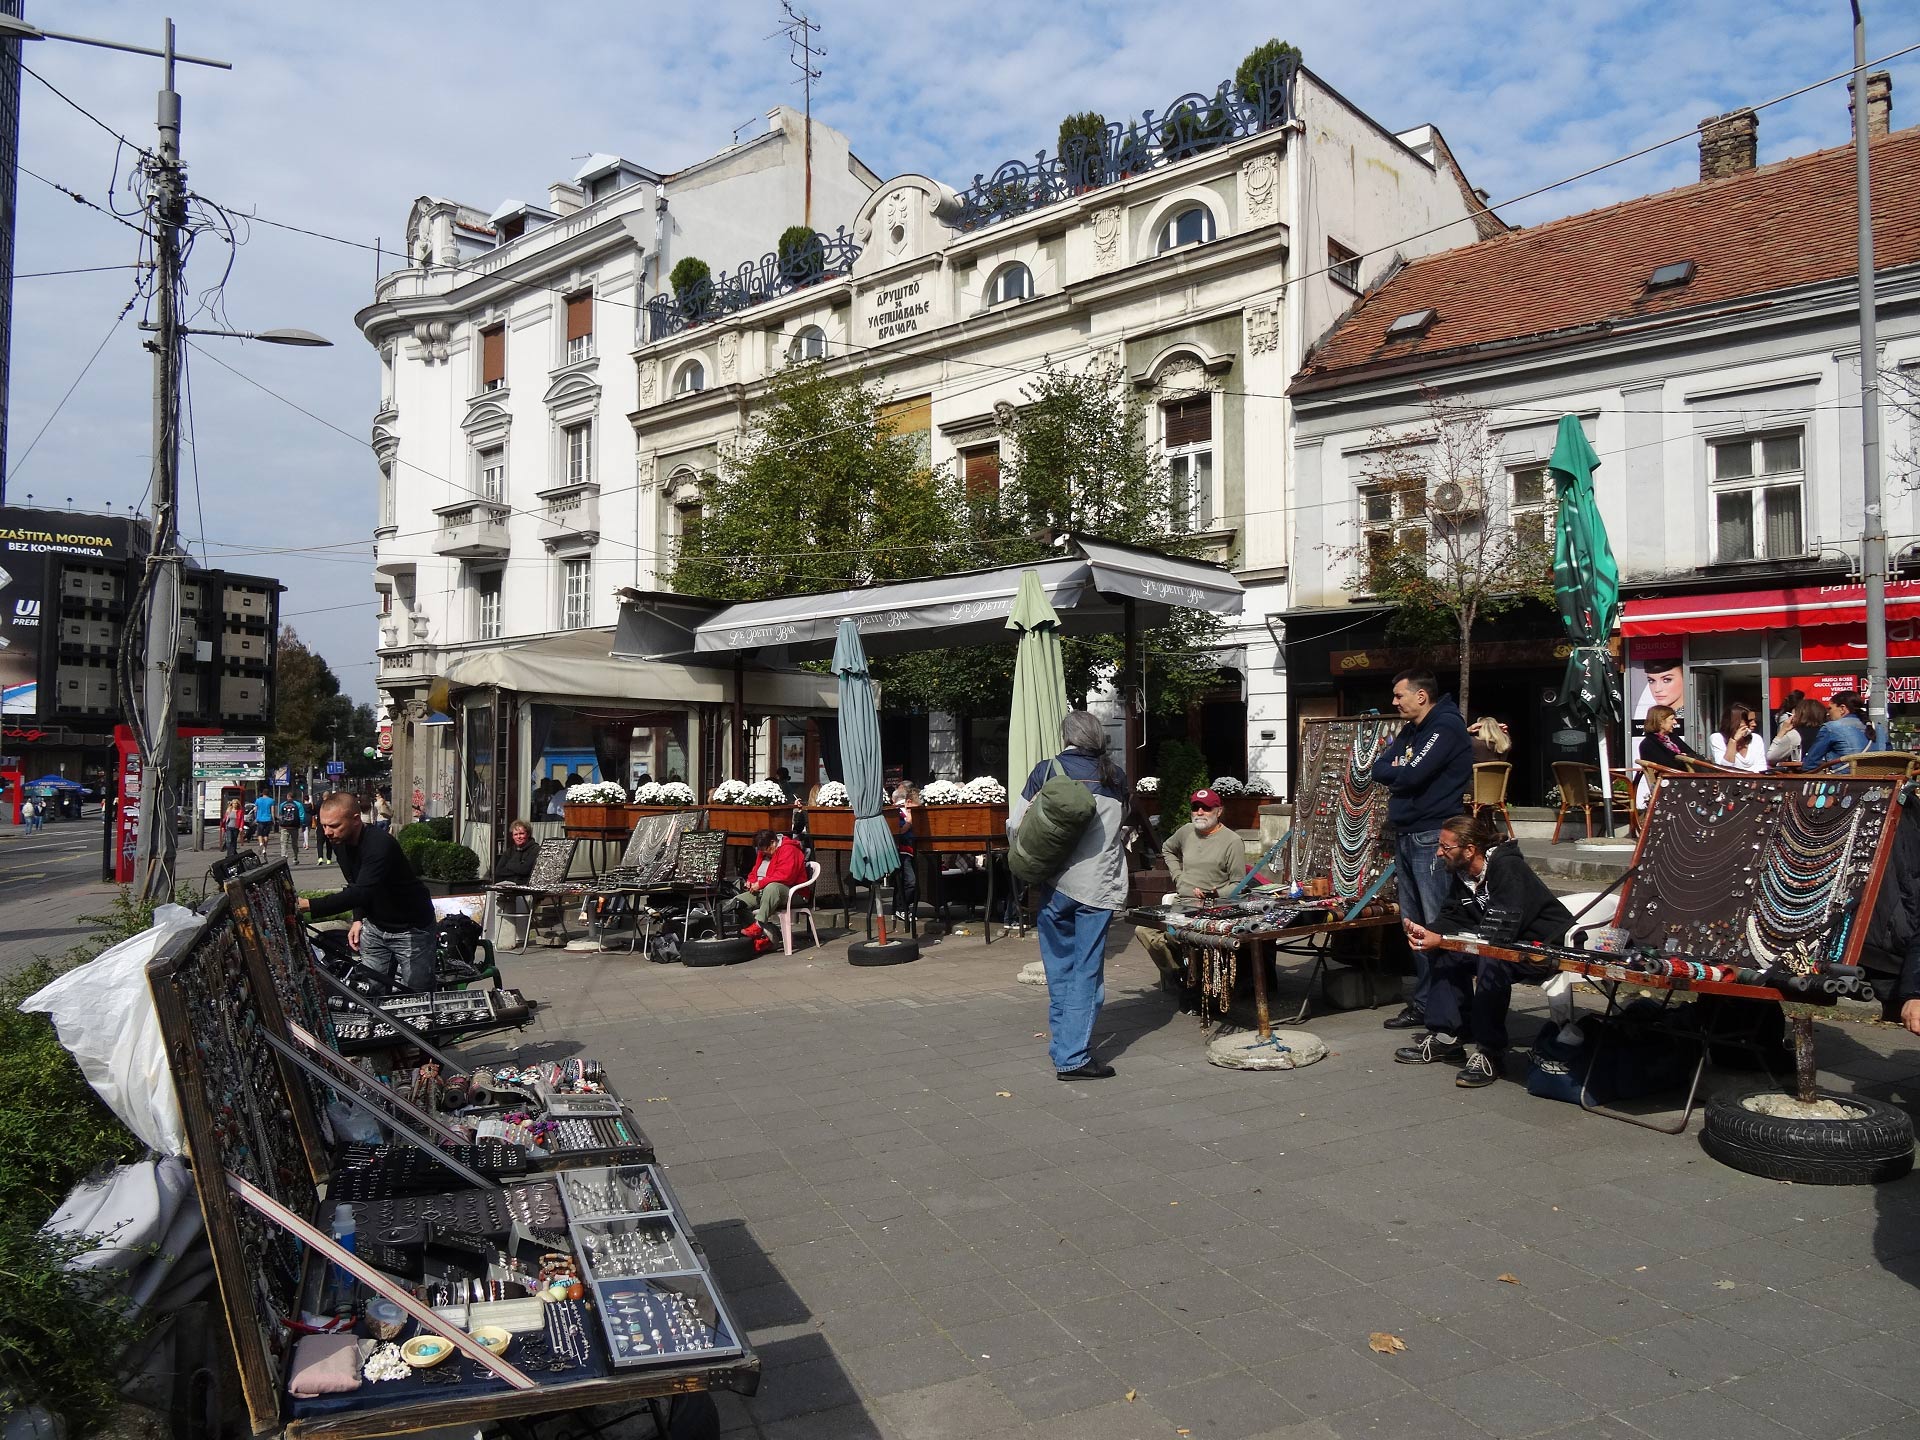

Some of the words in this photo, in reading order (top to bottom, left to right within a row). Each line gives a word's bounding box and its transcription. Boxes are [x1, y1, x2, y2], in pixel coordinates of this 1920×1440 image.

[877, 282, 920, 307] ДРУШТВО
[868, 301, 930, 328] УЛЕПШАВАЊЕ
[878, 320, 917, 340] ВРАЧАРА
[0, 528, 53, 542] ZAŠTITA
[56, 534, 113, 547] MOTORA
[8, 542, 29, 552] BEZ
[1419, 732, 1440, 757] STUDENT
